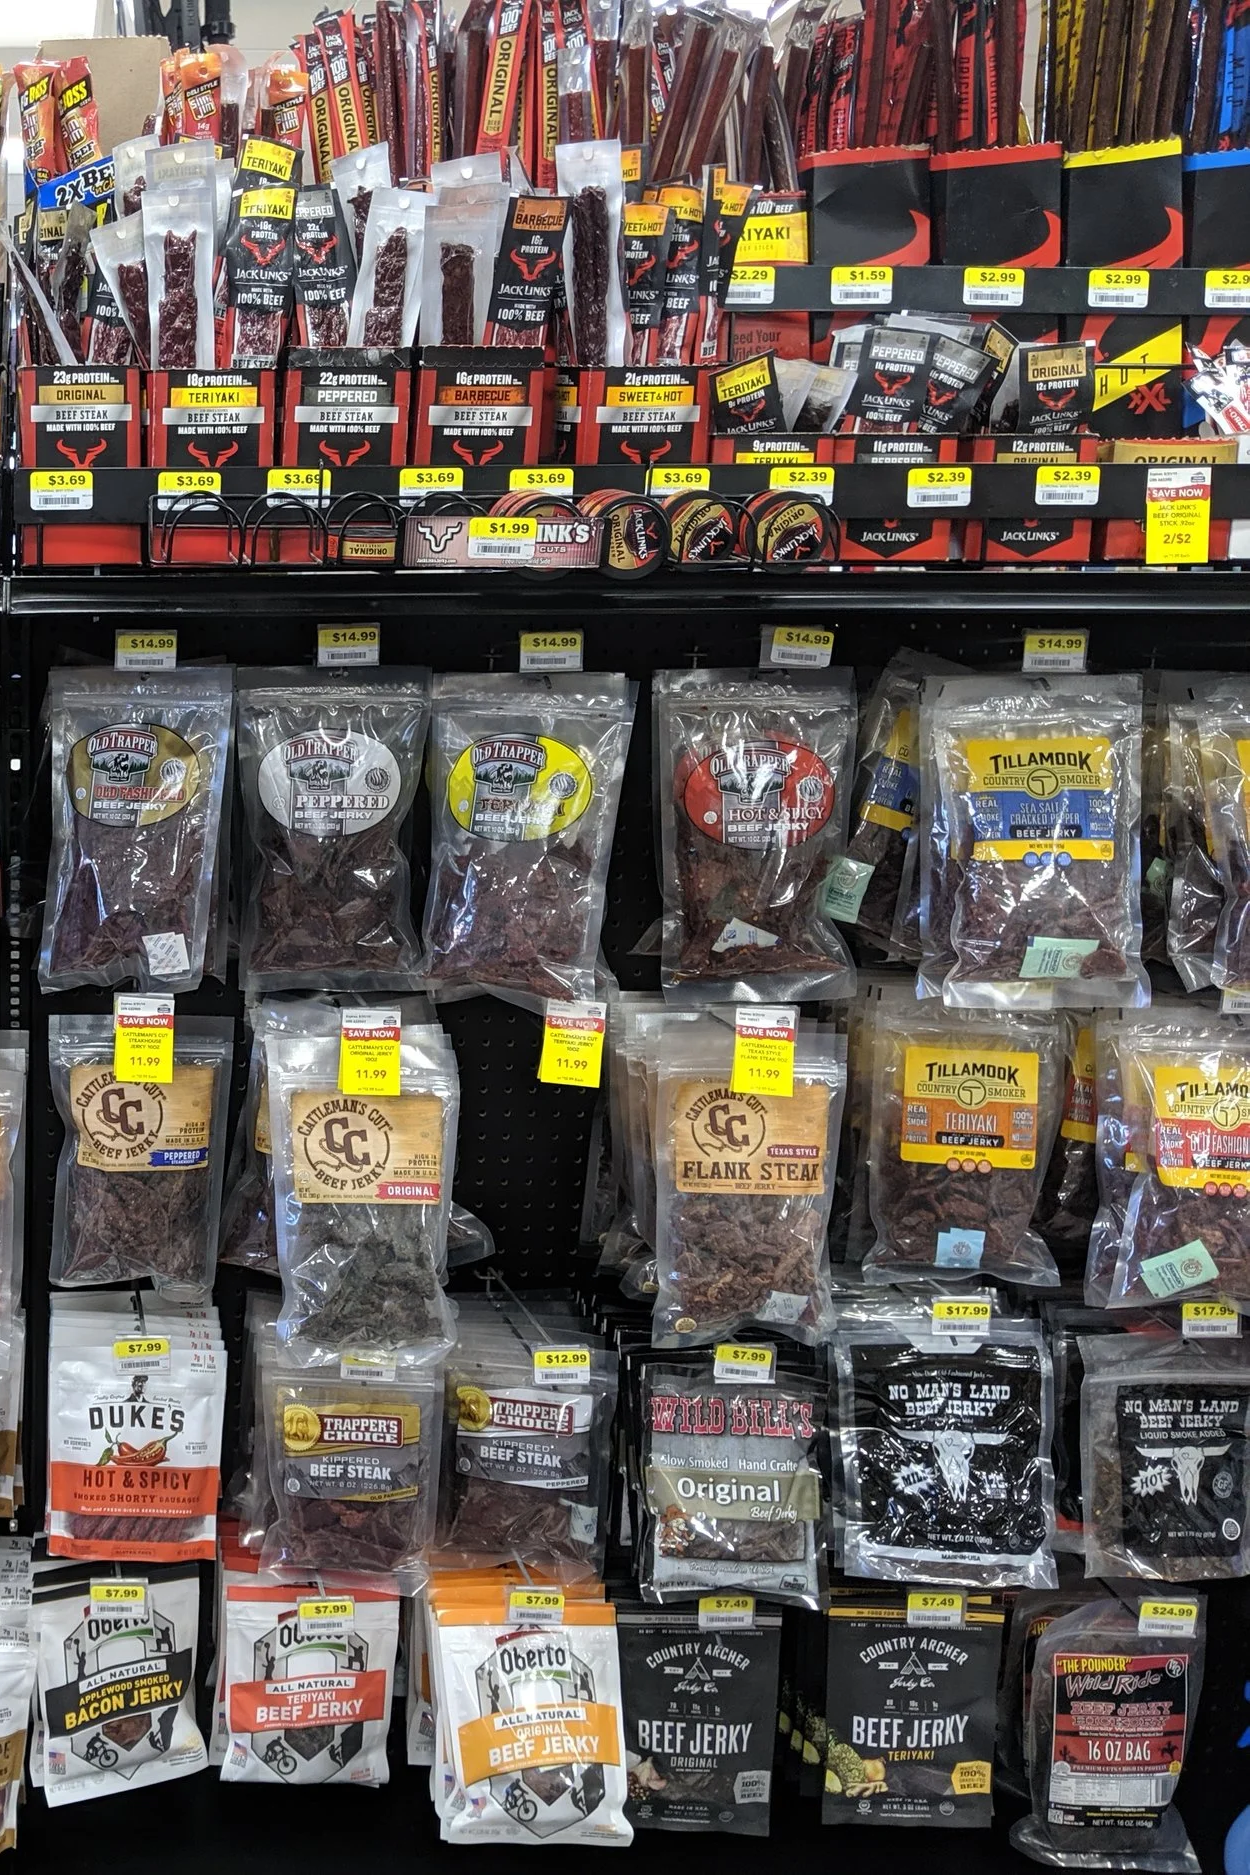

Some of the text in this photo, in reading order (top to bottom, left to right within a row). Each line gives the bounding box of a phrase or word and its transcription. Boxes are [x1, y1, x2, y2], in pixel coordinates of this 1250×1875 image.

[487, 39, 511, 118] ORIGINAL
[515, 214, 565, 226] BARBECUE
[520, 245, 550, 254] PROTEIN
[850, 270, 886, 280] $1.59
[1105, 274, 1141, 284] $2.99
[872, 346, 924, 362] PEPPERED
[1032, 364, 1082, 378] ORIGINAL
[53, 373, 110, 385] 23g PROTEIN
[721, 374, 769, 399] TERIYAKI
[56, 389, 106, 401] ORIGINAL
[188, 392, 239, 404] TERIYAKI
[318, 390, 378, 403] PEPPERED
[455, 390, 511, 401] BARBECUE
[58, 409, 112, 422] BEEF STEAK
[49, 475, 86, 486] $3.69
[928, 472, 965, 482] $2.39
[1153, 489, 1202, 498] SAVE NOW
[1163, 532, 1191, 545] 2/$2
[130, 638, 174, 649] $14.99
[1038, 638, 1082, 649] $14.99
[989, 751, 1093, 775] TILLAMOOK
[983, 774, 1101, 787] COUNTRY SMOKER
[296, 795, 389, 809] PEPPERED
[348, 1029, 394, 1039] SAVE NOW
[355, 1069, 386, 1080] 11.99
[945, 1112, 998, 1133] TERIYAKI
[942, 1135, 1000, 1147] BEEF JERKY
[683, 1161, 819, 1181] FLANK STEAK
[387, 1186, 434, 1197] ORIGINAL
[947, 1306, 988, 1316] $17.99
[546, 1353, 587, 1364] $12.99
[889, 1383, 1011, 1401] NO MAN'S LAND
[652, 1396, 813, 1438] WILD BILL'S
[323, 1418, 398, 1433] TRAPPER'S
[323, 1430, 398, 1444] CHOICE
[83, 1468, 191, 1491] HOT & SPICY
[1140, 1472, 1166, 1490] HOT
[677, 1477, 780, 1503] Original
[314, 1605, 347, 1615] $7.99
[1152, 1608, 1192, 1618] $24.99
[500, 1647, 565, 1672] Oberto
[64, 1680, 183, 1730] BACON JERKY
[287, 1692, 336, 1705] TERIYAKI
[852, 1715, 970, 1745] BEEF JERKY
[888, 1750, 935, 1761] TERIYAKI
[1088, 1741, 1151, 1760] 16 OZ BAG
